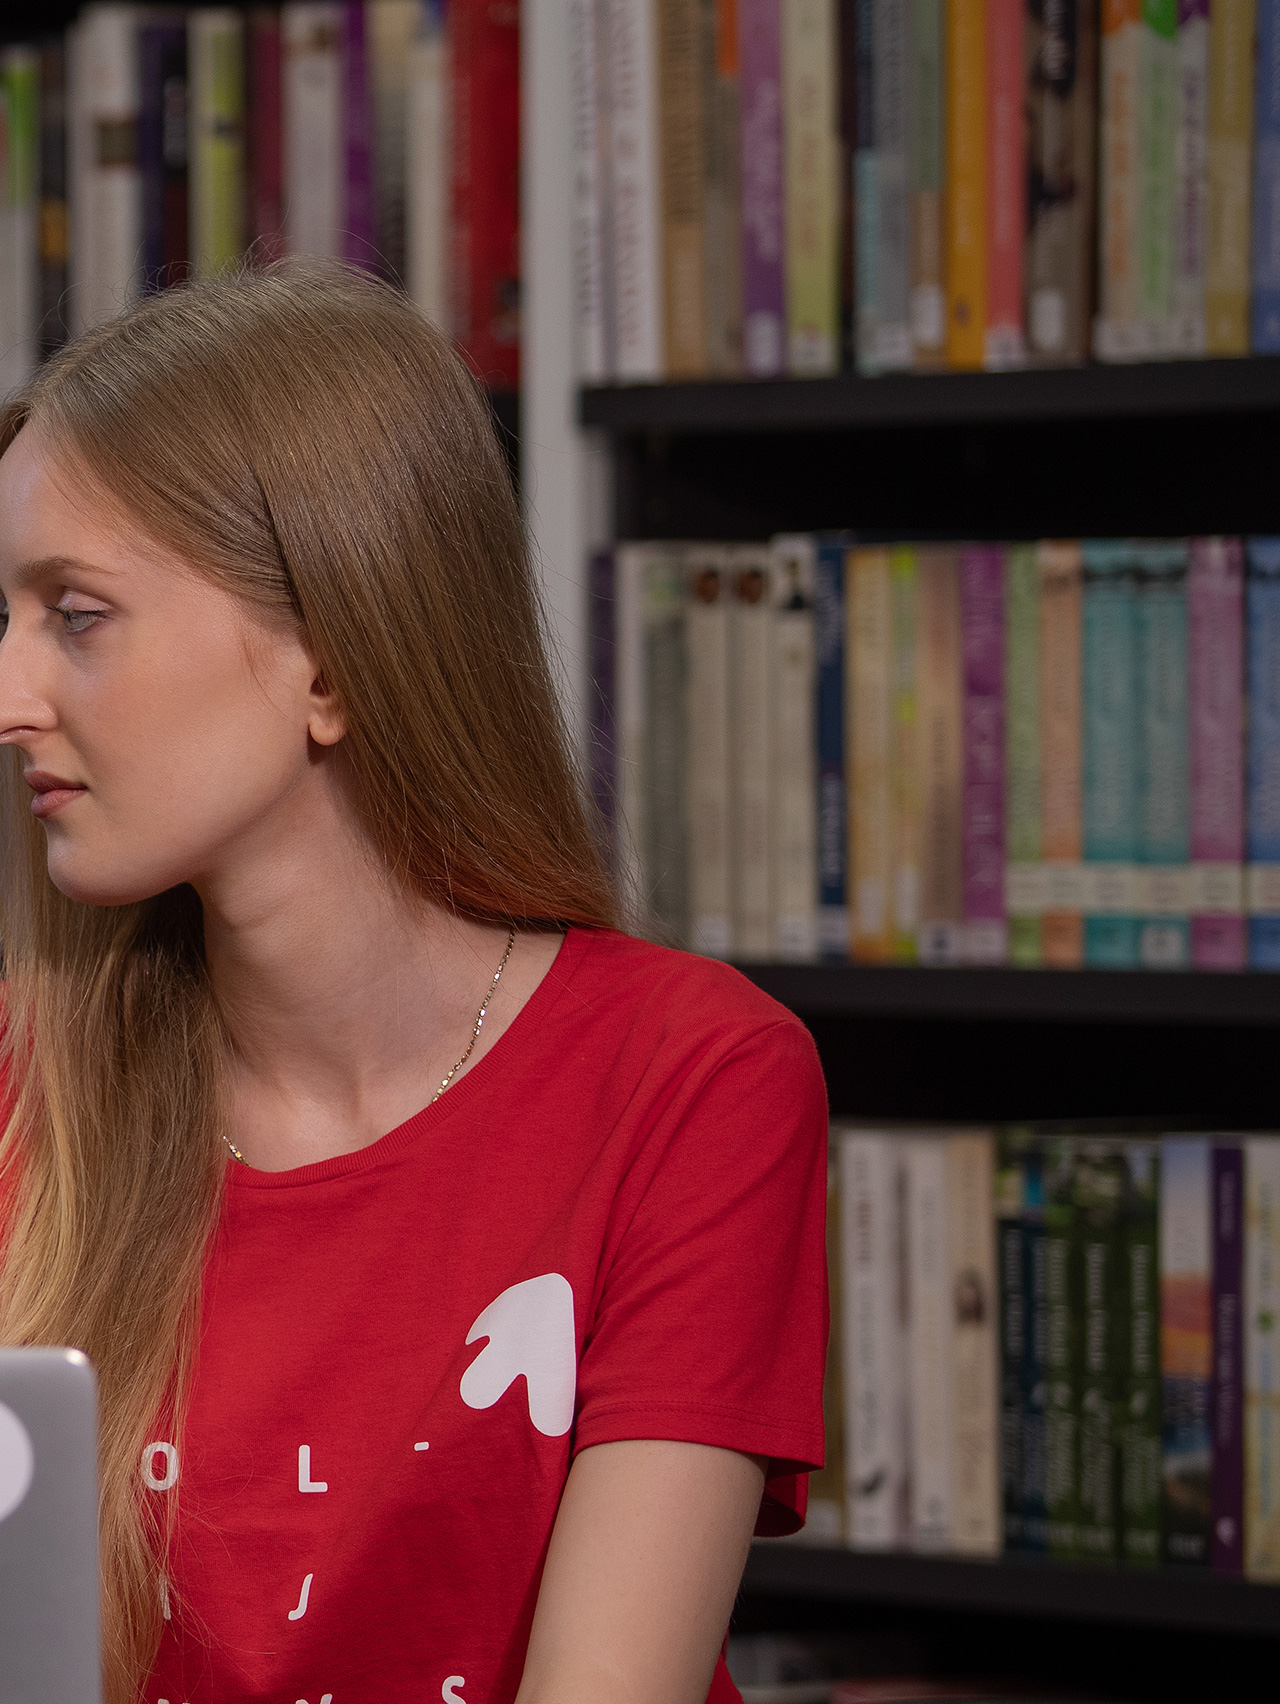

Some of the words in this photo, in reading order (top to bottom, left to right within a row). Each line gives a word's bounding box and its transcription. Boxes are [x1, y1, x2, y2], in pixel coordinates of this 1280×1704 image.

[141, 1441, 180, 1492] O
[298, 1444, 329, 1493] L
[287, 1572, 314, 1621] J
